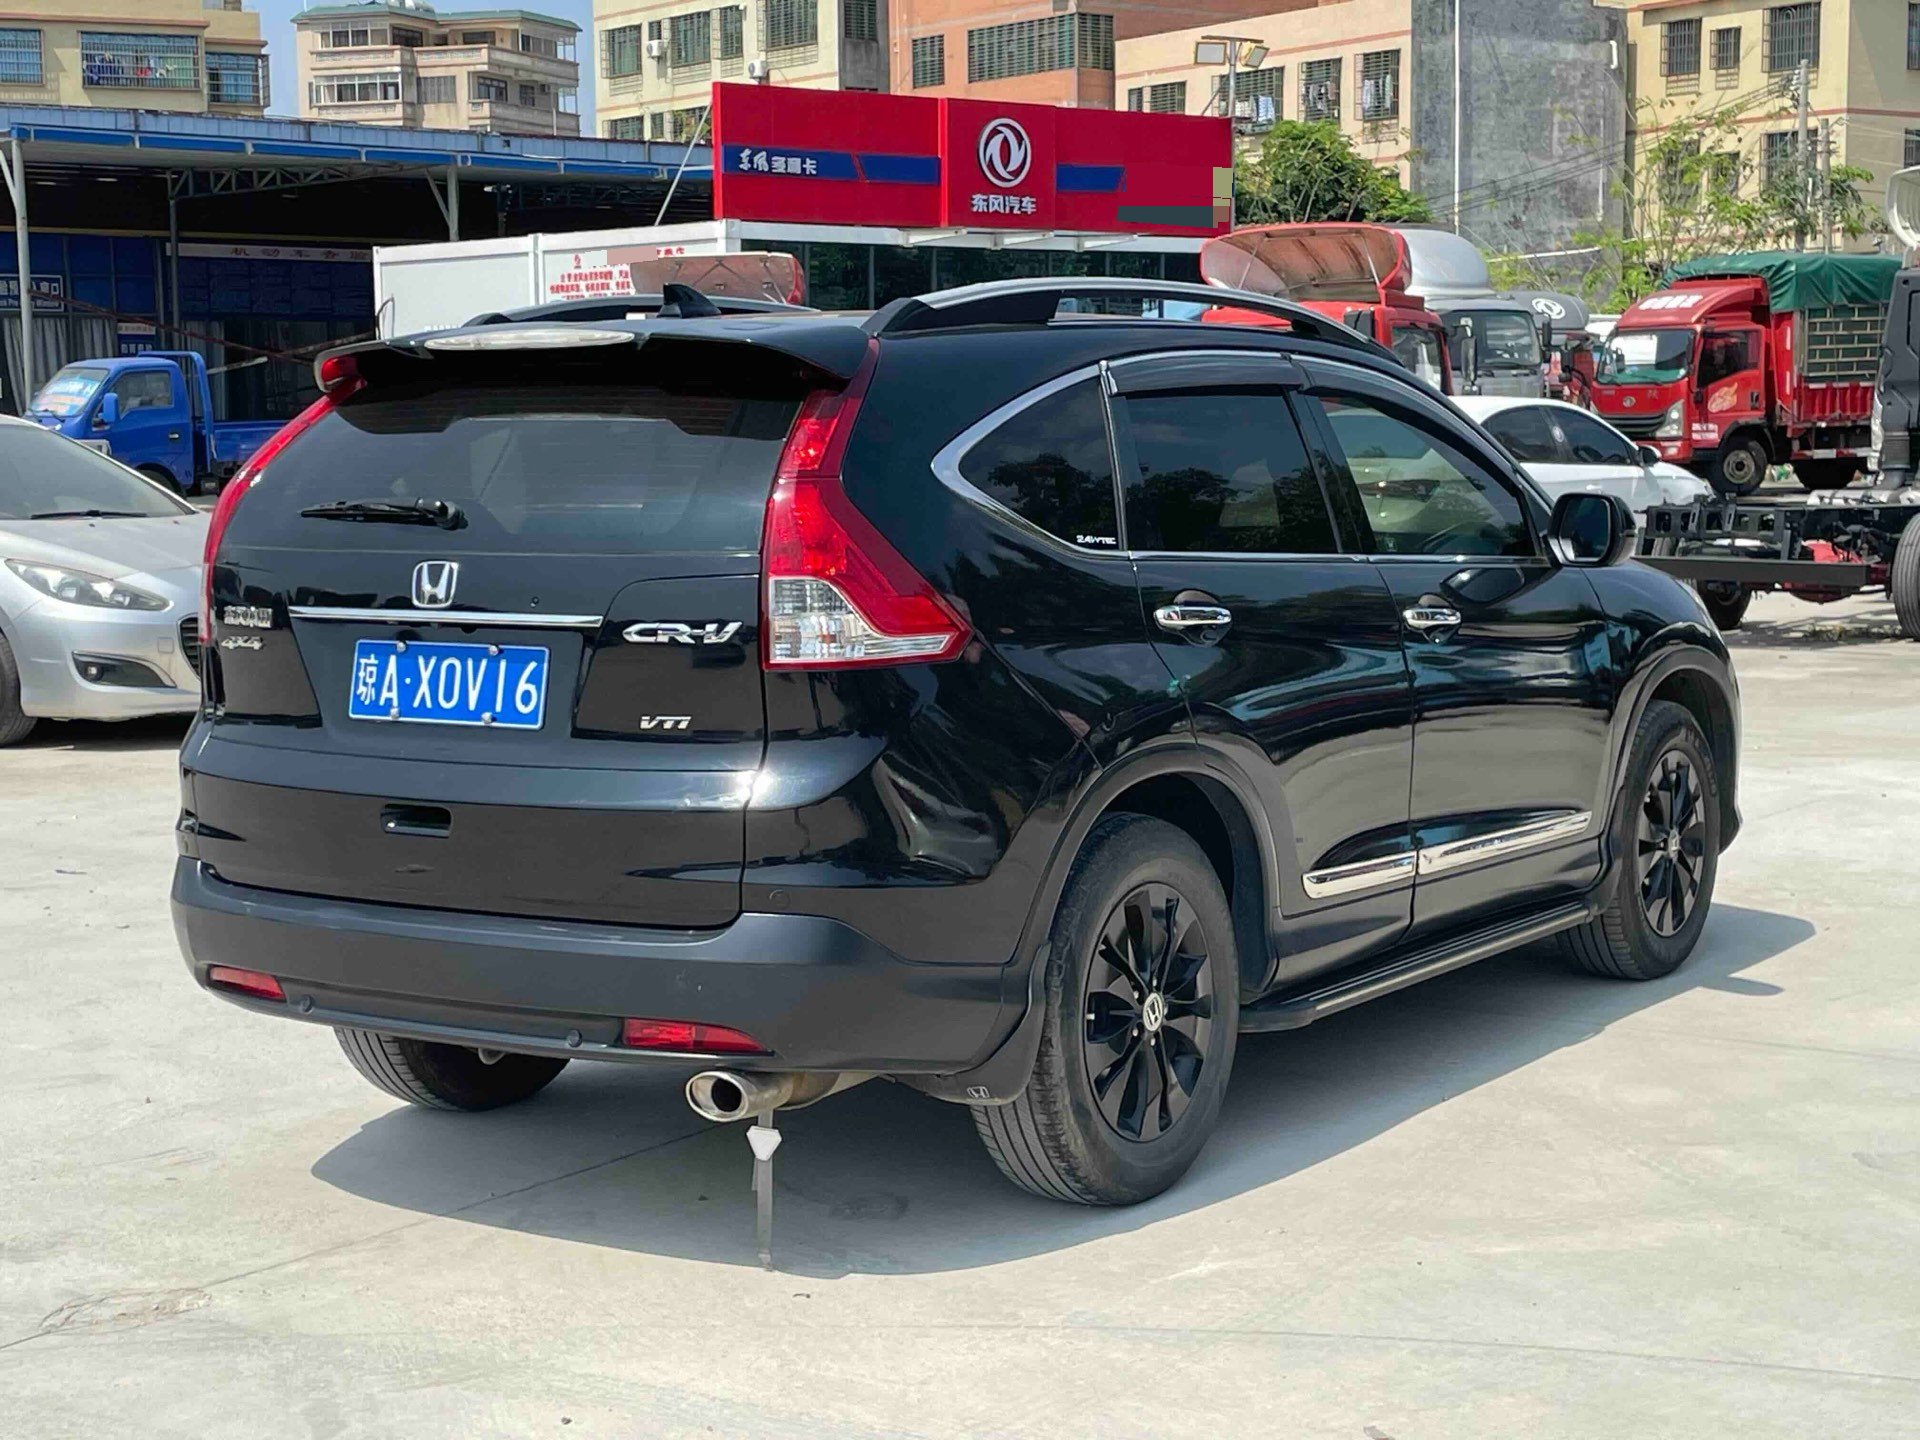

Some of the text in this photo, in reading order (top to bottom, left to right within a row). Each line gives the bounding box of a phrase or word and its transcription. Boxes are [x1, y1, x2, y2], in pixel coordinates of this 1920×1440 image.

[971, 193, 1037, 214] 东风汽车
[622, 621, 743, 644] CR-V
